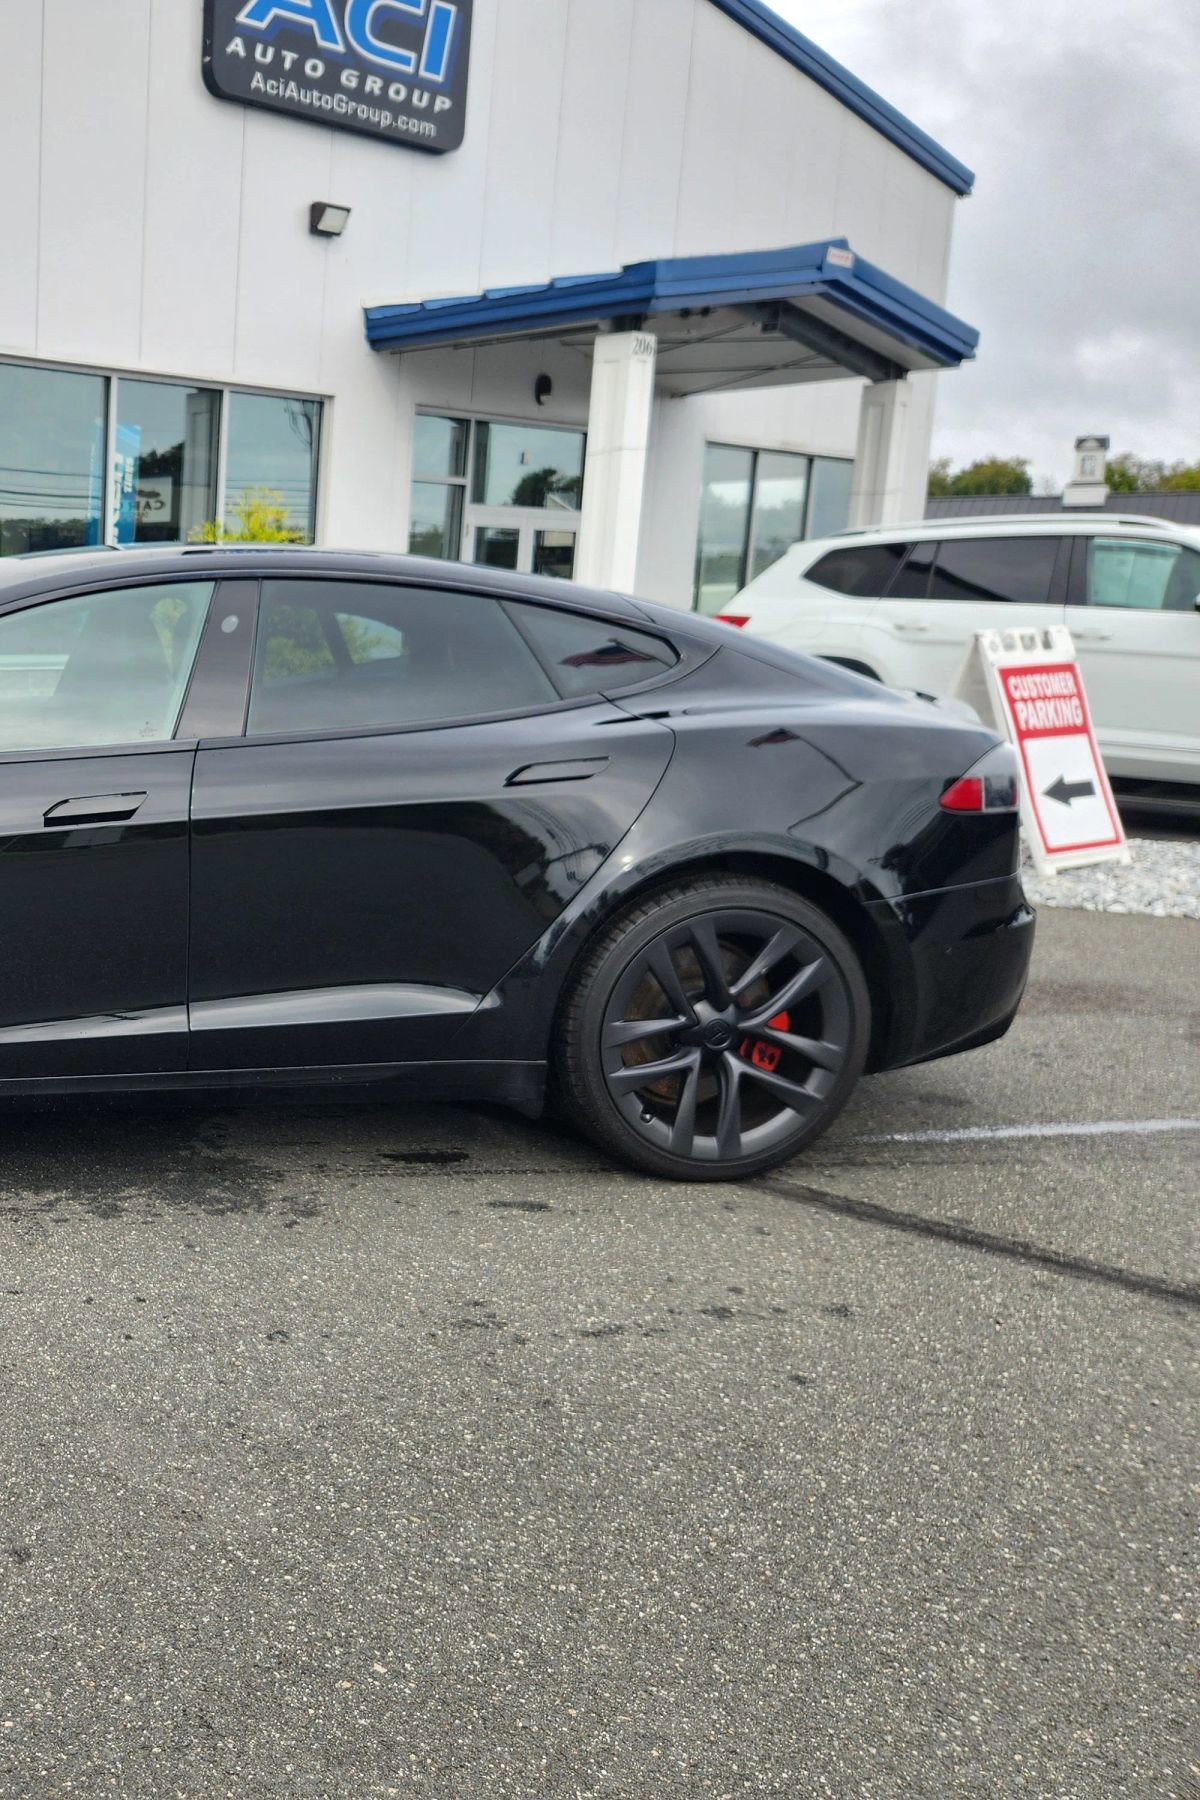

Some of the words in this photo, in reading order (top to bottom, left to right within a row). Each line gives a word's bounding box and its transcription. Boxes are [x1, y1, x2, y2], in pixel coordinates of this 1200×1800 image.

[226, 36, 325, 78] AUTO
[340, 69, 452, 114] GROUP
[250, 71, 438, 138] AciAutoGroup.com
[1007, 671, 1077, 699] CUSTOMER
[1014, 696, 1084, 731] PARKING
